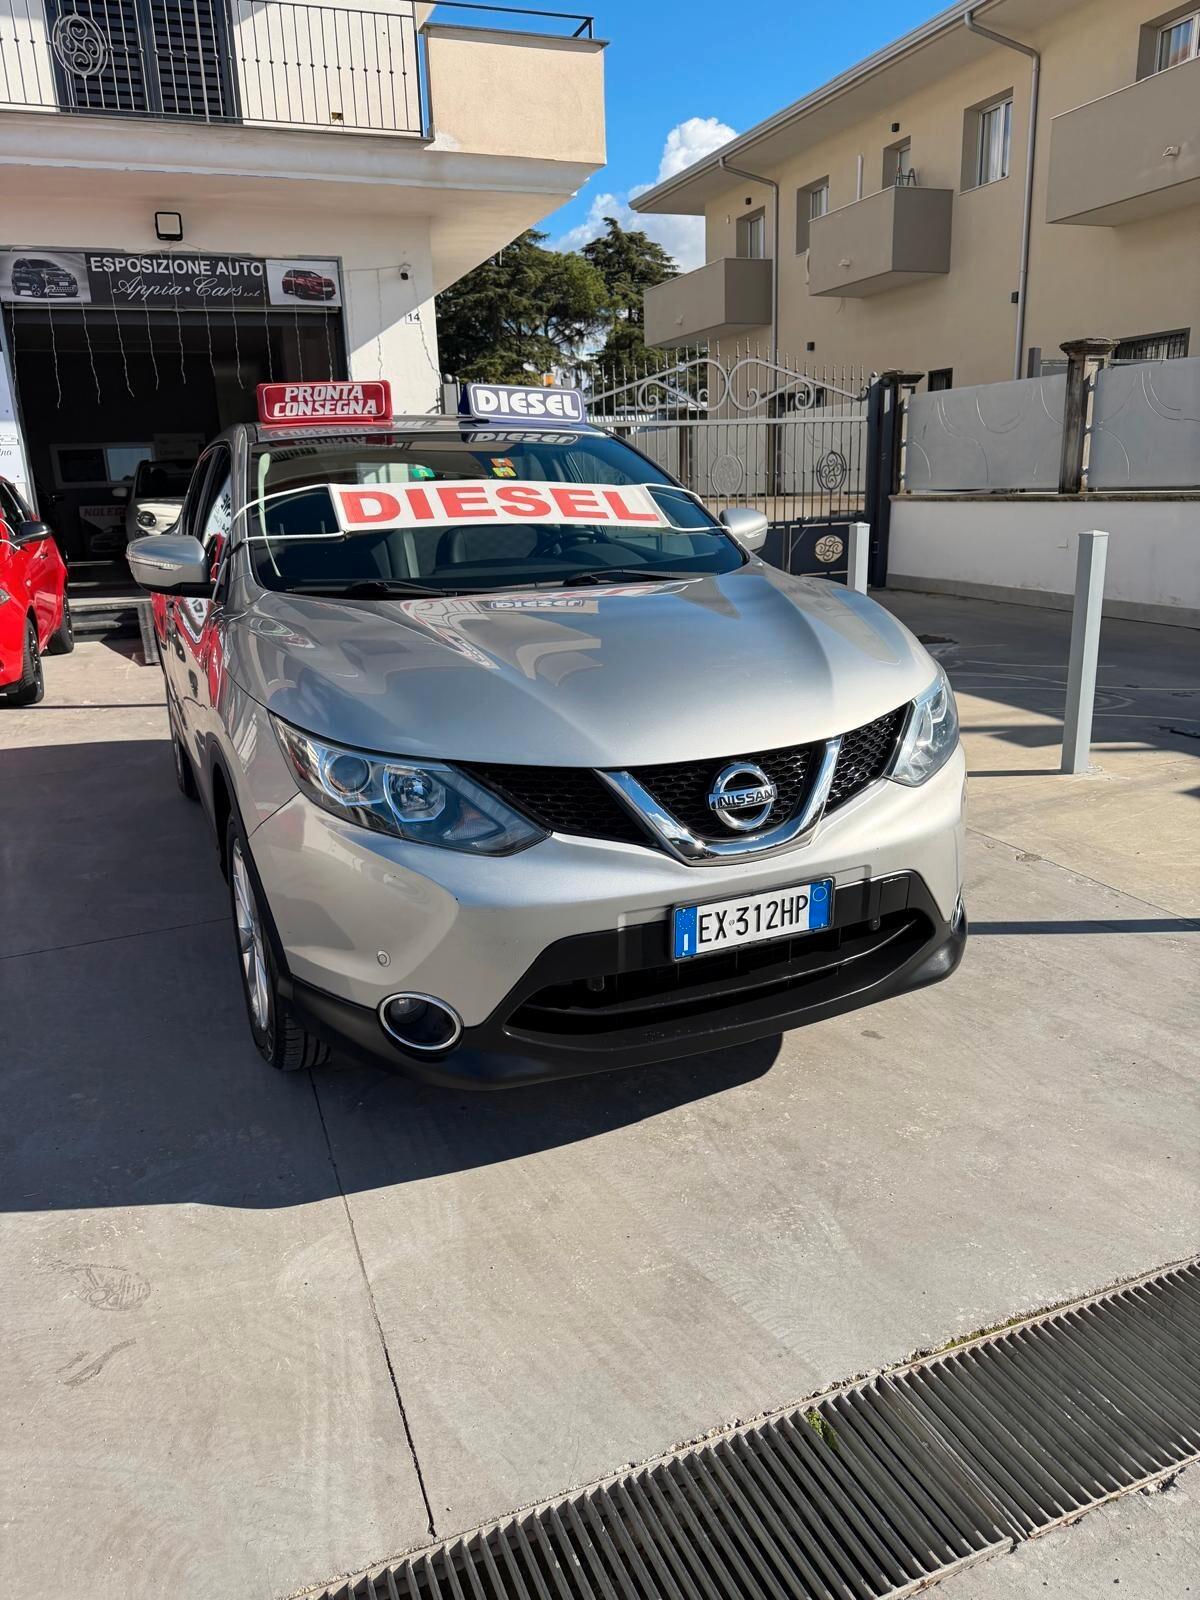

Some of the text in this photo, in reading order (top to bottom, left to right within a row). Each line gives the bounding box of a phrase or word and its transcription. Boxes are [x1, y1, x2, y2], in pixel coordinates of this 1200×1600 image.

[90, 257, 264, 276] ESPOSIZIONE AUTO
[112, 276, 183, 301] Appia
[193, 277, 242, 297] Cars
[407, 313, 420, 322] 14
[284, 385, 364, 402] PRONTA
[476, 389, 579, 417] DIESEL
[273, 399, 378, 417] CONSEGNA
[338, 486, 660, 524] DIESEL
[717, 788, 774, 808] NISSAN
